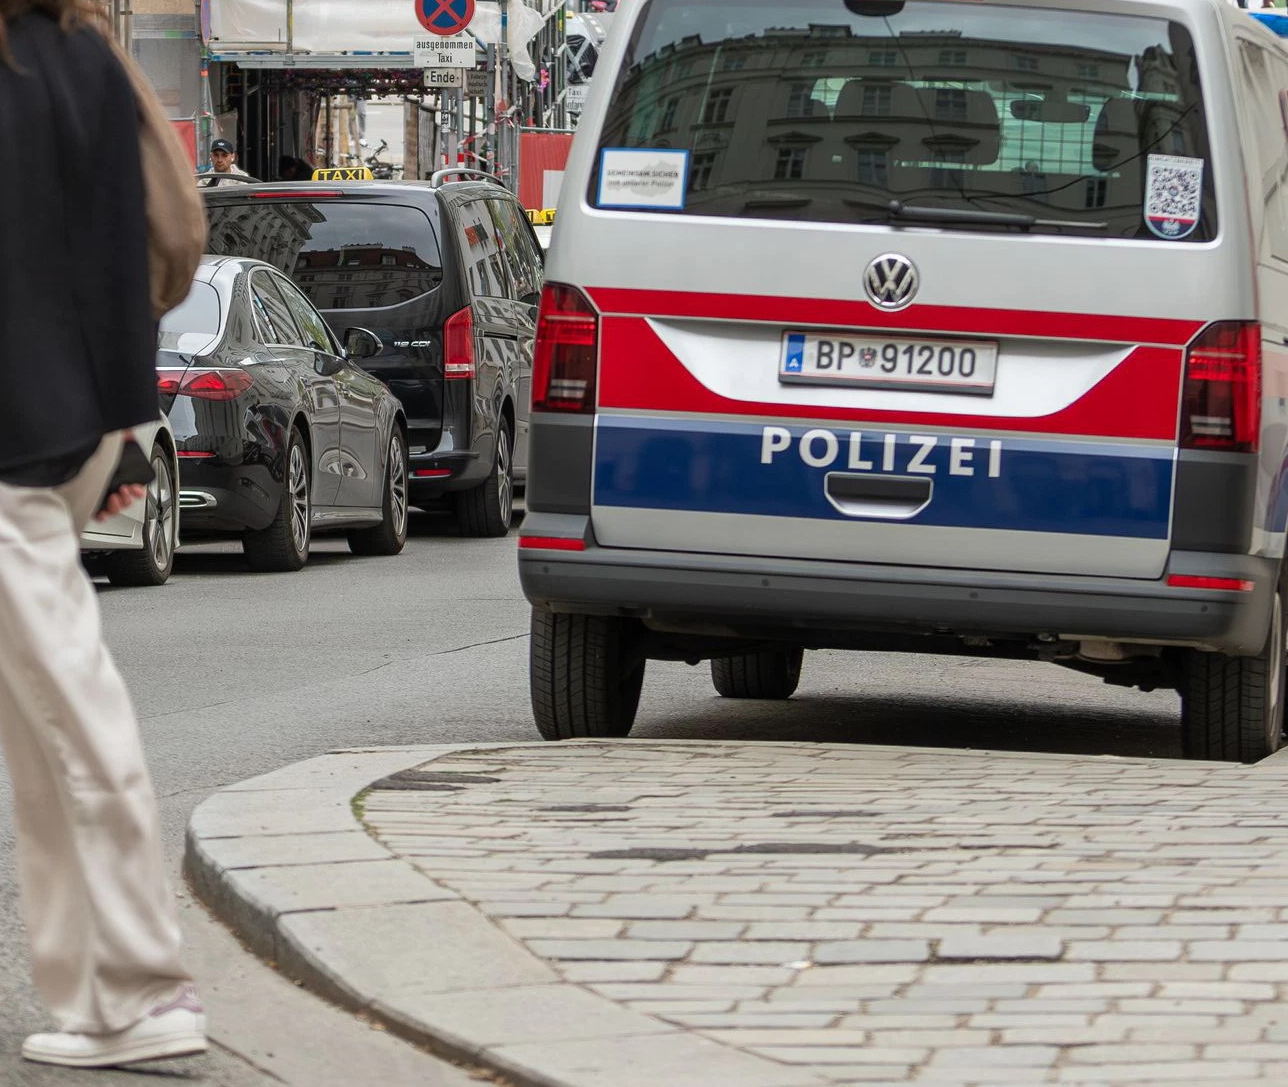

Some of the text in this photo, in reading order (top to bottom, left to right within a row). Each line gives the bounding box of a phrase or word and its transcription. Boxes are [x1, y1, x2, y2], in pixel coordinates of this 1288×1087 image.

[416, 40, 473, 50] ausgenommen
[437, 52, 453, 63] Taxi
[430, 71, 455, 83] Ende
[320, 169, 363, 182] TAXI
[789, 340, 976, 377] A BP 91200
[760, 426, 1002, 478] POLIZEI
